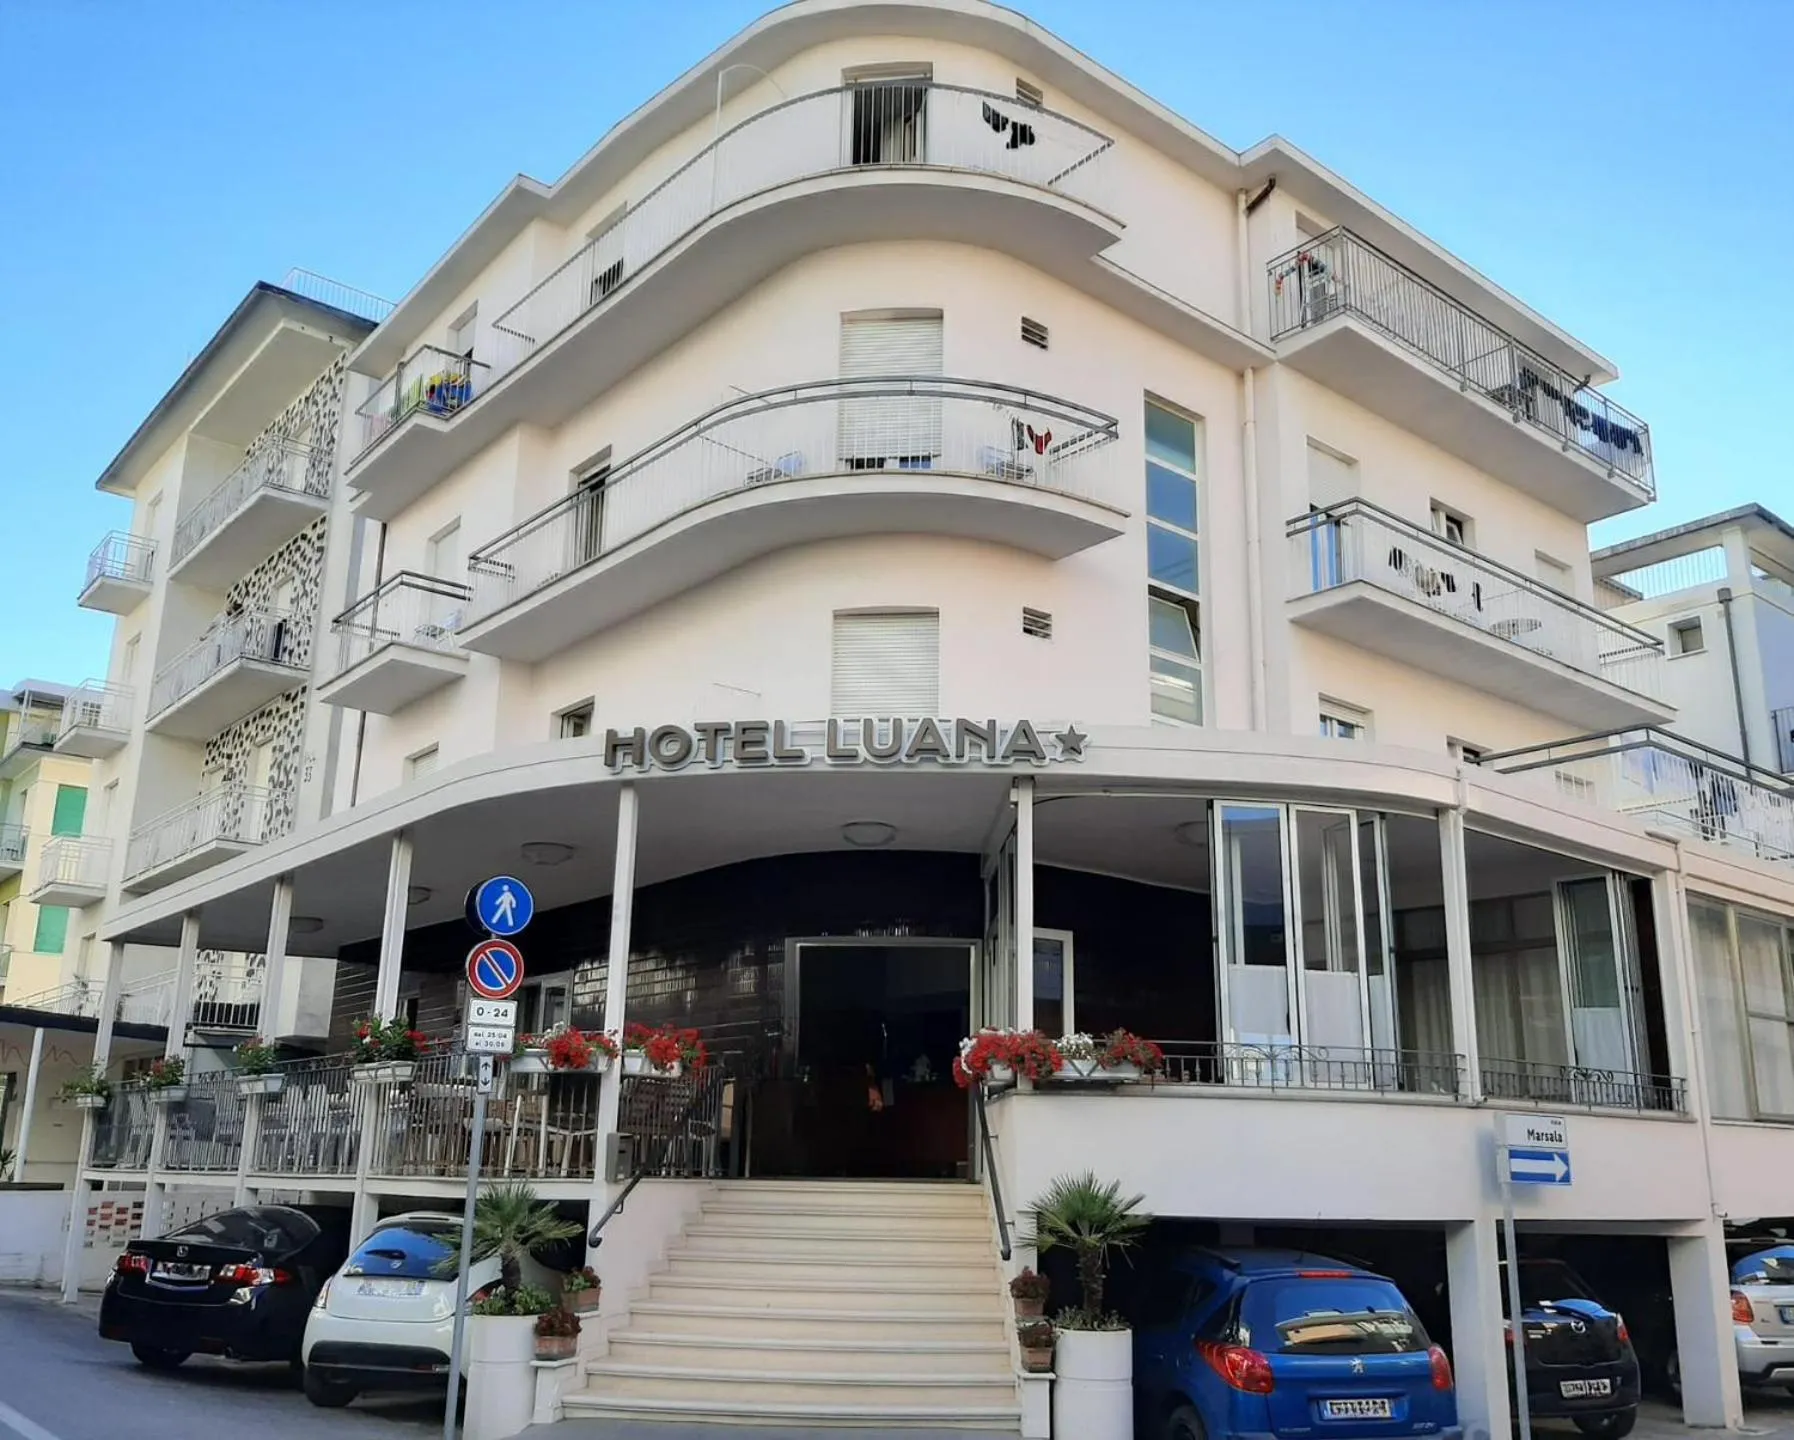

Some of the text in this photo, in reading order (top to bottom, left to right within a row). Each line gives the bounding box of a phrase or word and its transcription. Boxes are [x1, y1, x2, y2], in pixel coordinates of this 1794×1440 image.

[604, 718, 1048, 769] HOTEL LUANA
[1527, 1128, 1564, 1143] Marsala
